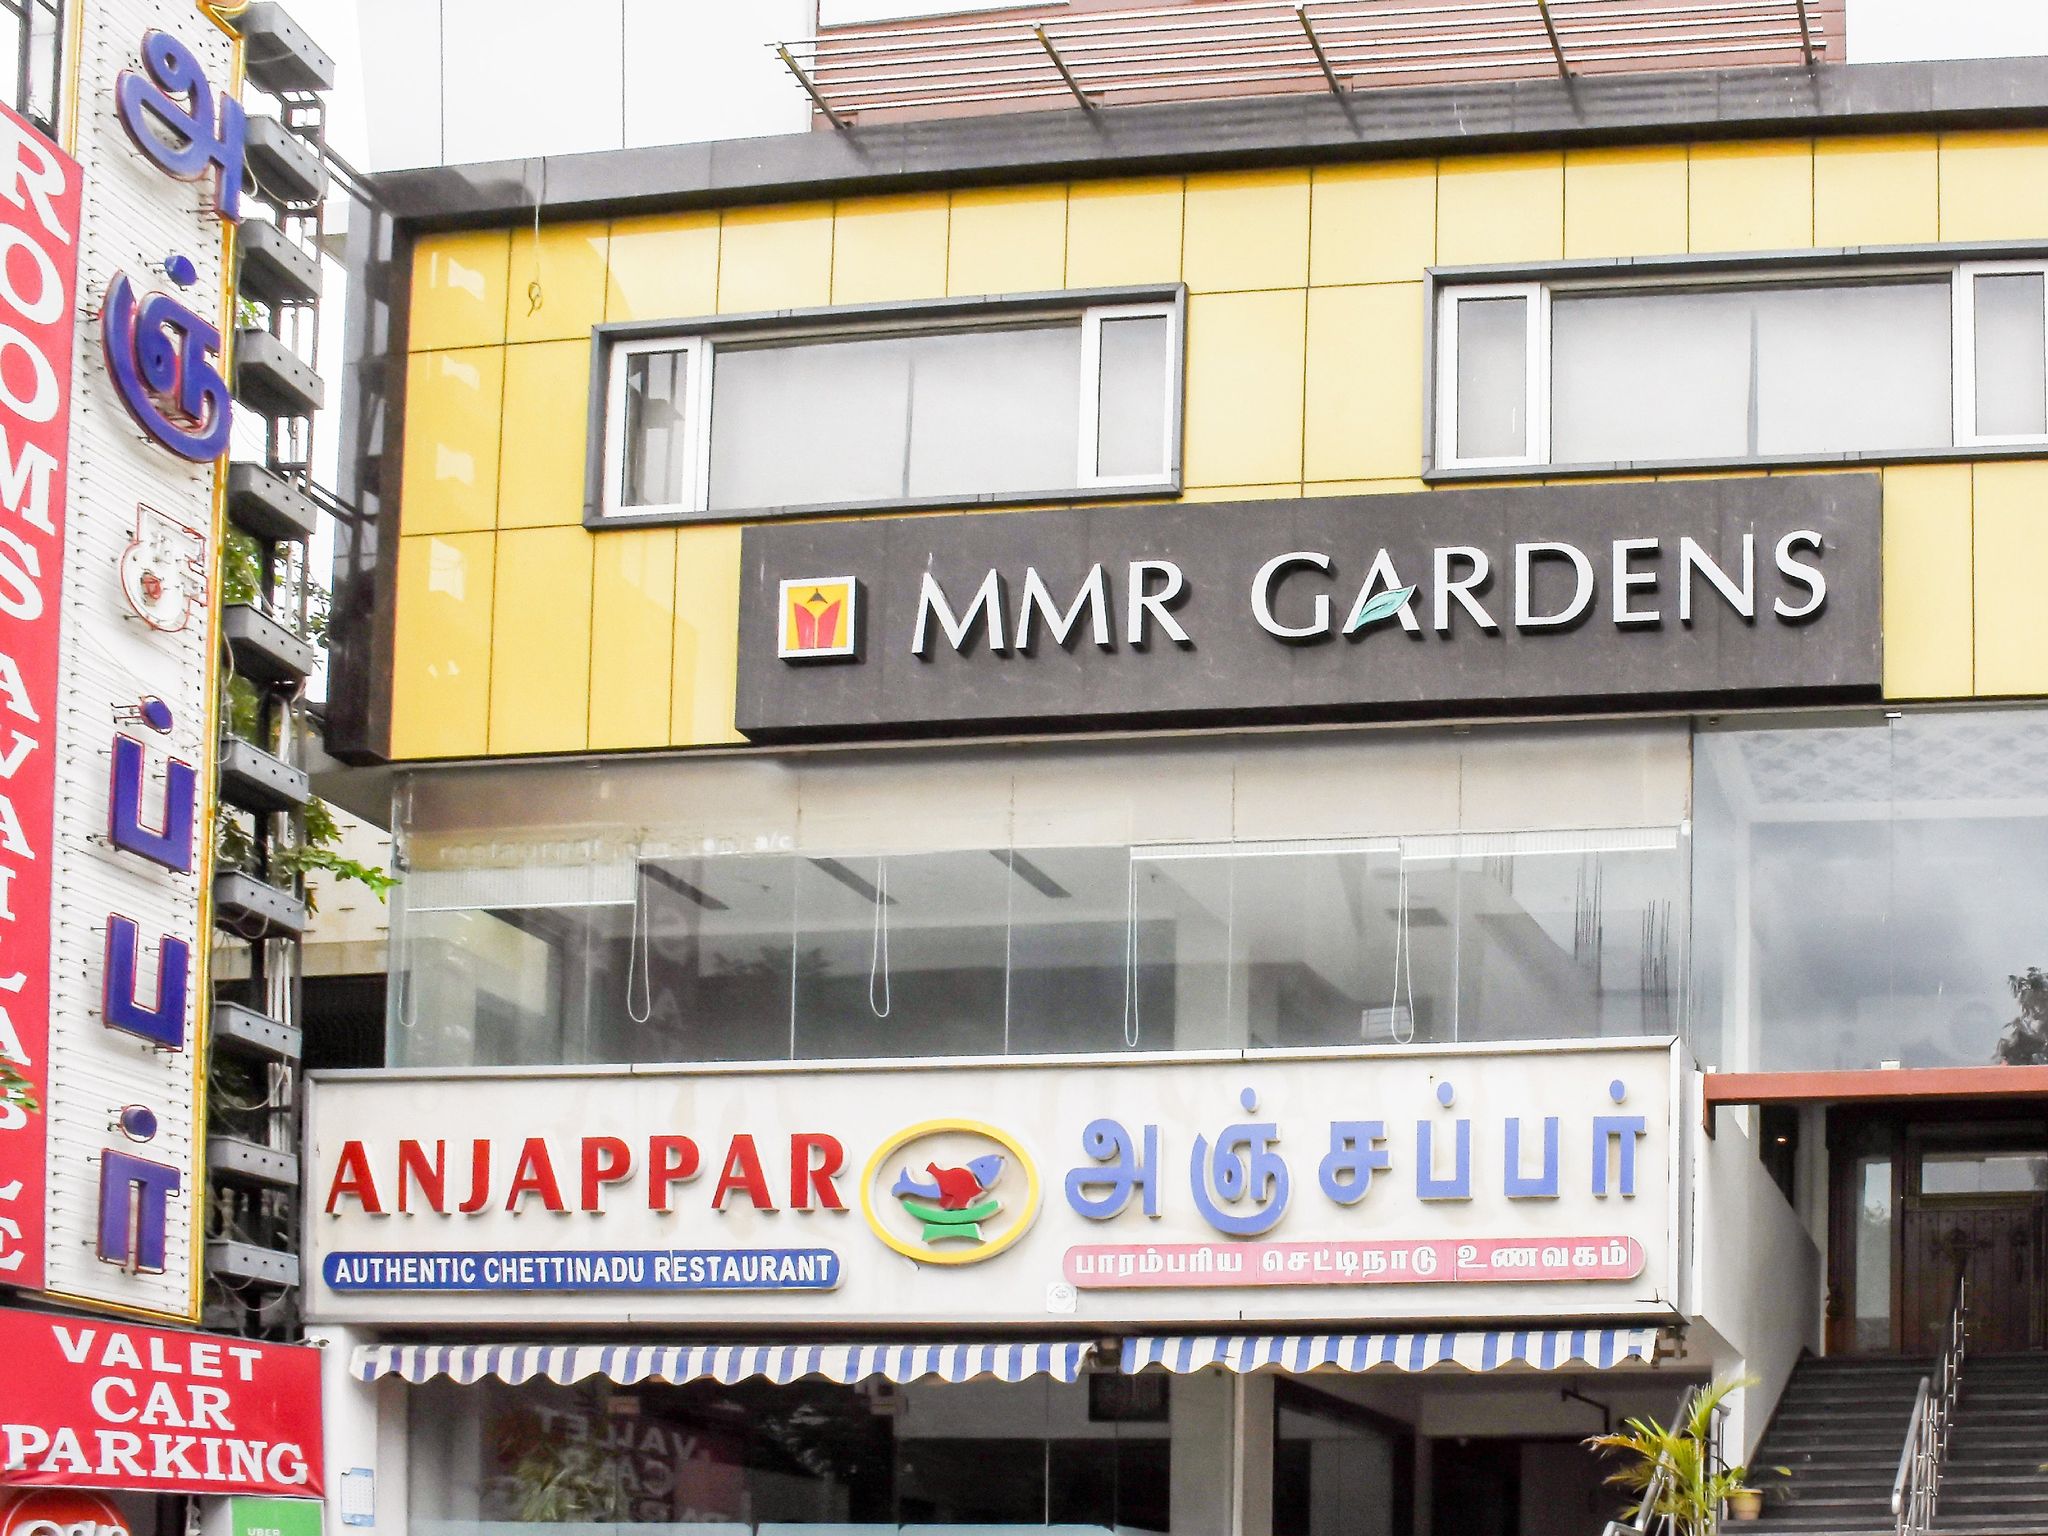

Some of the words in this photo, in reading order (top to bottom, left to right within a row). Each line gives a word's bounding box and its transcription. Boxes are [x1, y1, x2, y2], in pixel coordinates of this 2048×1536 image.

[911, 560, 1192, 655] MMR
[1250, 530, 1828, 640] GARDENS
[325, 1132, 850, 1217] ANJAPPAR
[1065, 1079, 1646, 1236] அஞ்சப்பர்
[334, 1257, 477, 1286] AUTHENTIC
[483, 1255, 646, 1285] CHETTINADU
[653, 1253, 832, 1284] RESTAURANT
[1075, 1249, 1243, 1277] பாரம்பரிய
[1260, 1246, 1437, 1277] செட்டிநாடு
[1456, 1239, 1628, 1271] உணவகம்
[51, 1325, 263, 1381] VALET
[90, 1376, 236, 1431] CAR
[1, 1423, 309, 1485] PARKING
